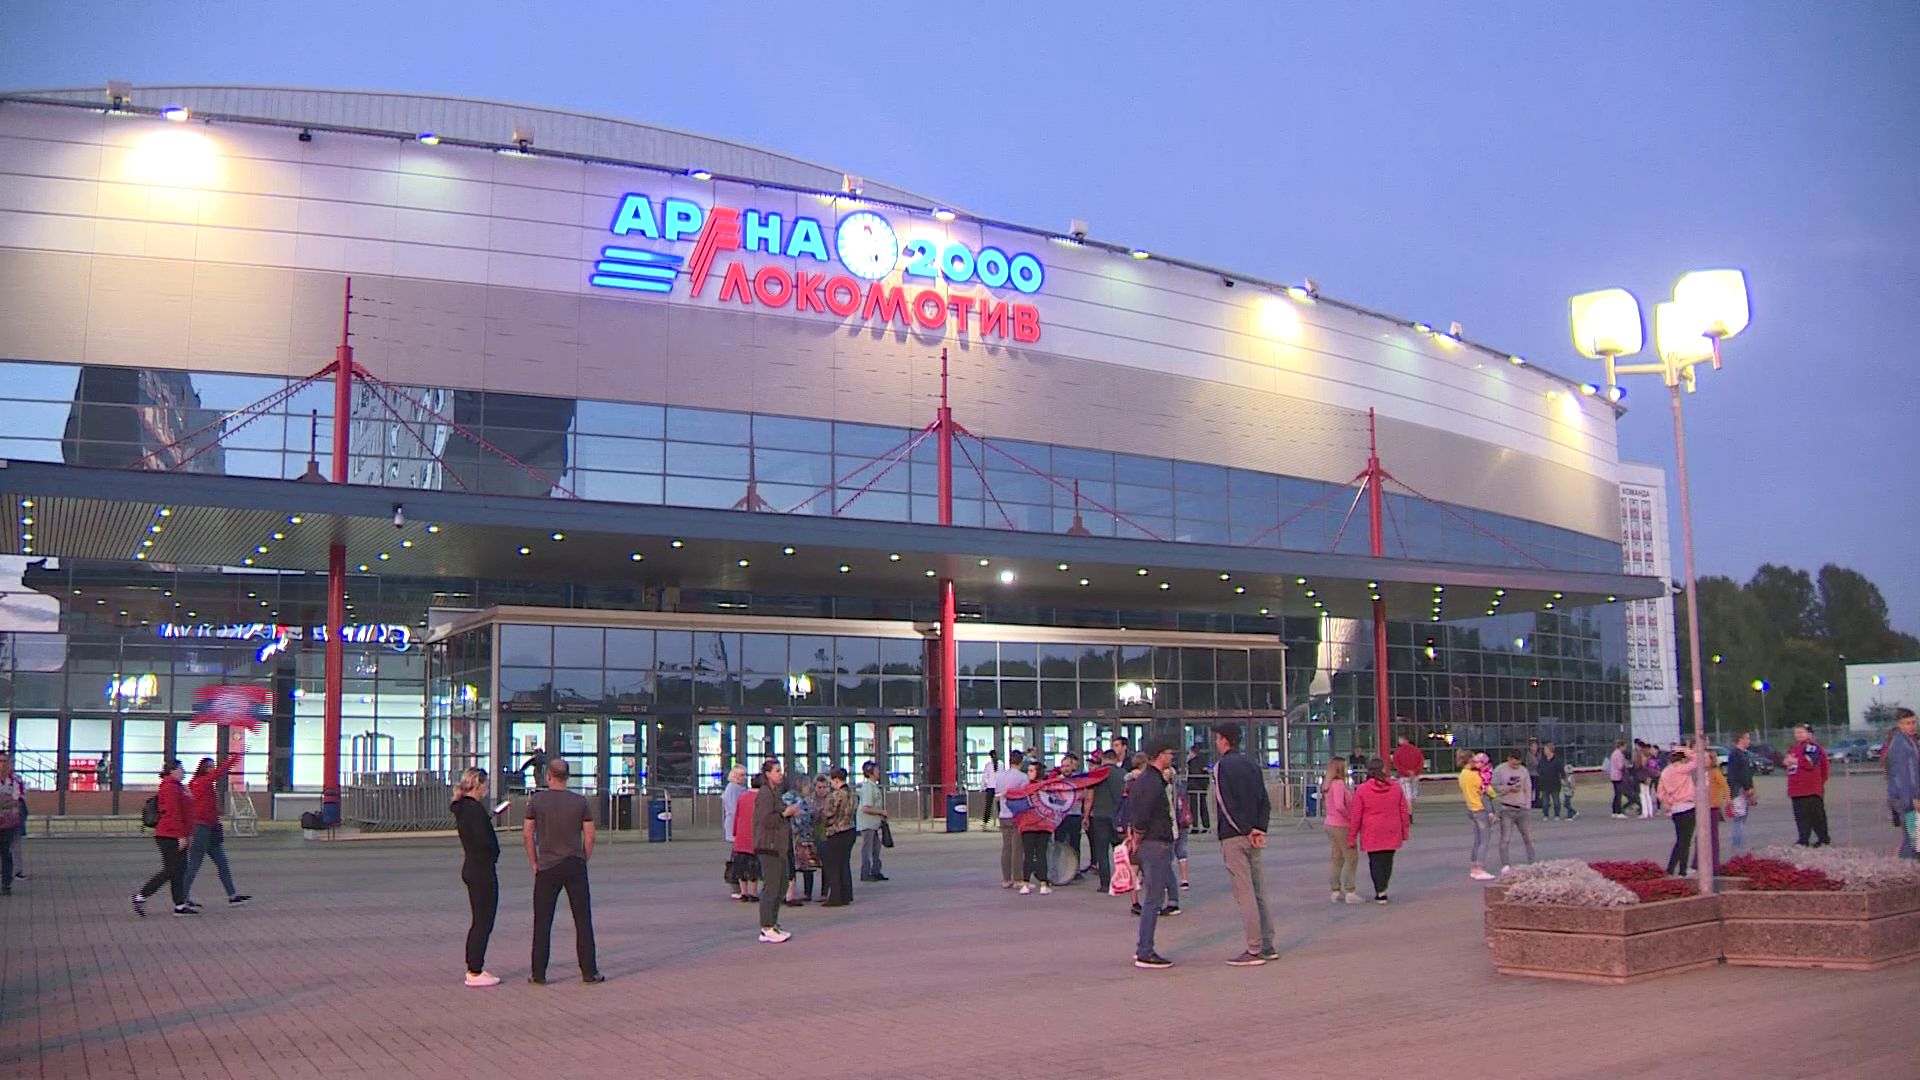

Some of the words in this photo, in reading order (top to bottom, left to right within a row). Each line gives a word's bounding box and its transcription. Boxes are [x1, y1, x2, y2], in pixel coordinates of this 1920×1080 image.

[612, 191, 830, 284] АРЕНА
[902, 235, 1044, 295] 2000
[719, 261, 1042, 345] ЛОКОМОТИВ
